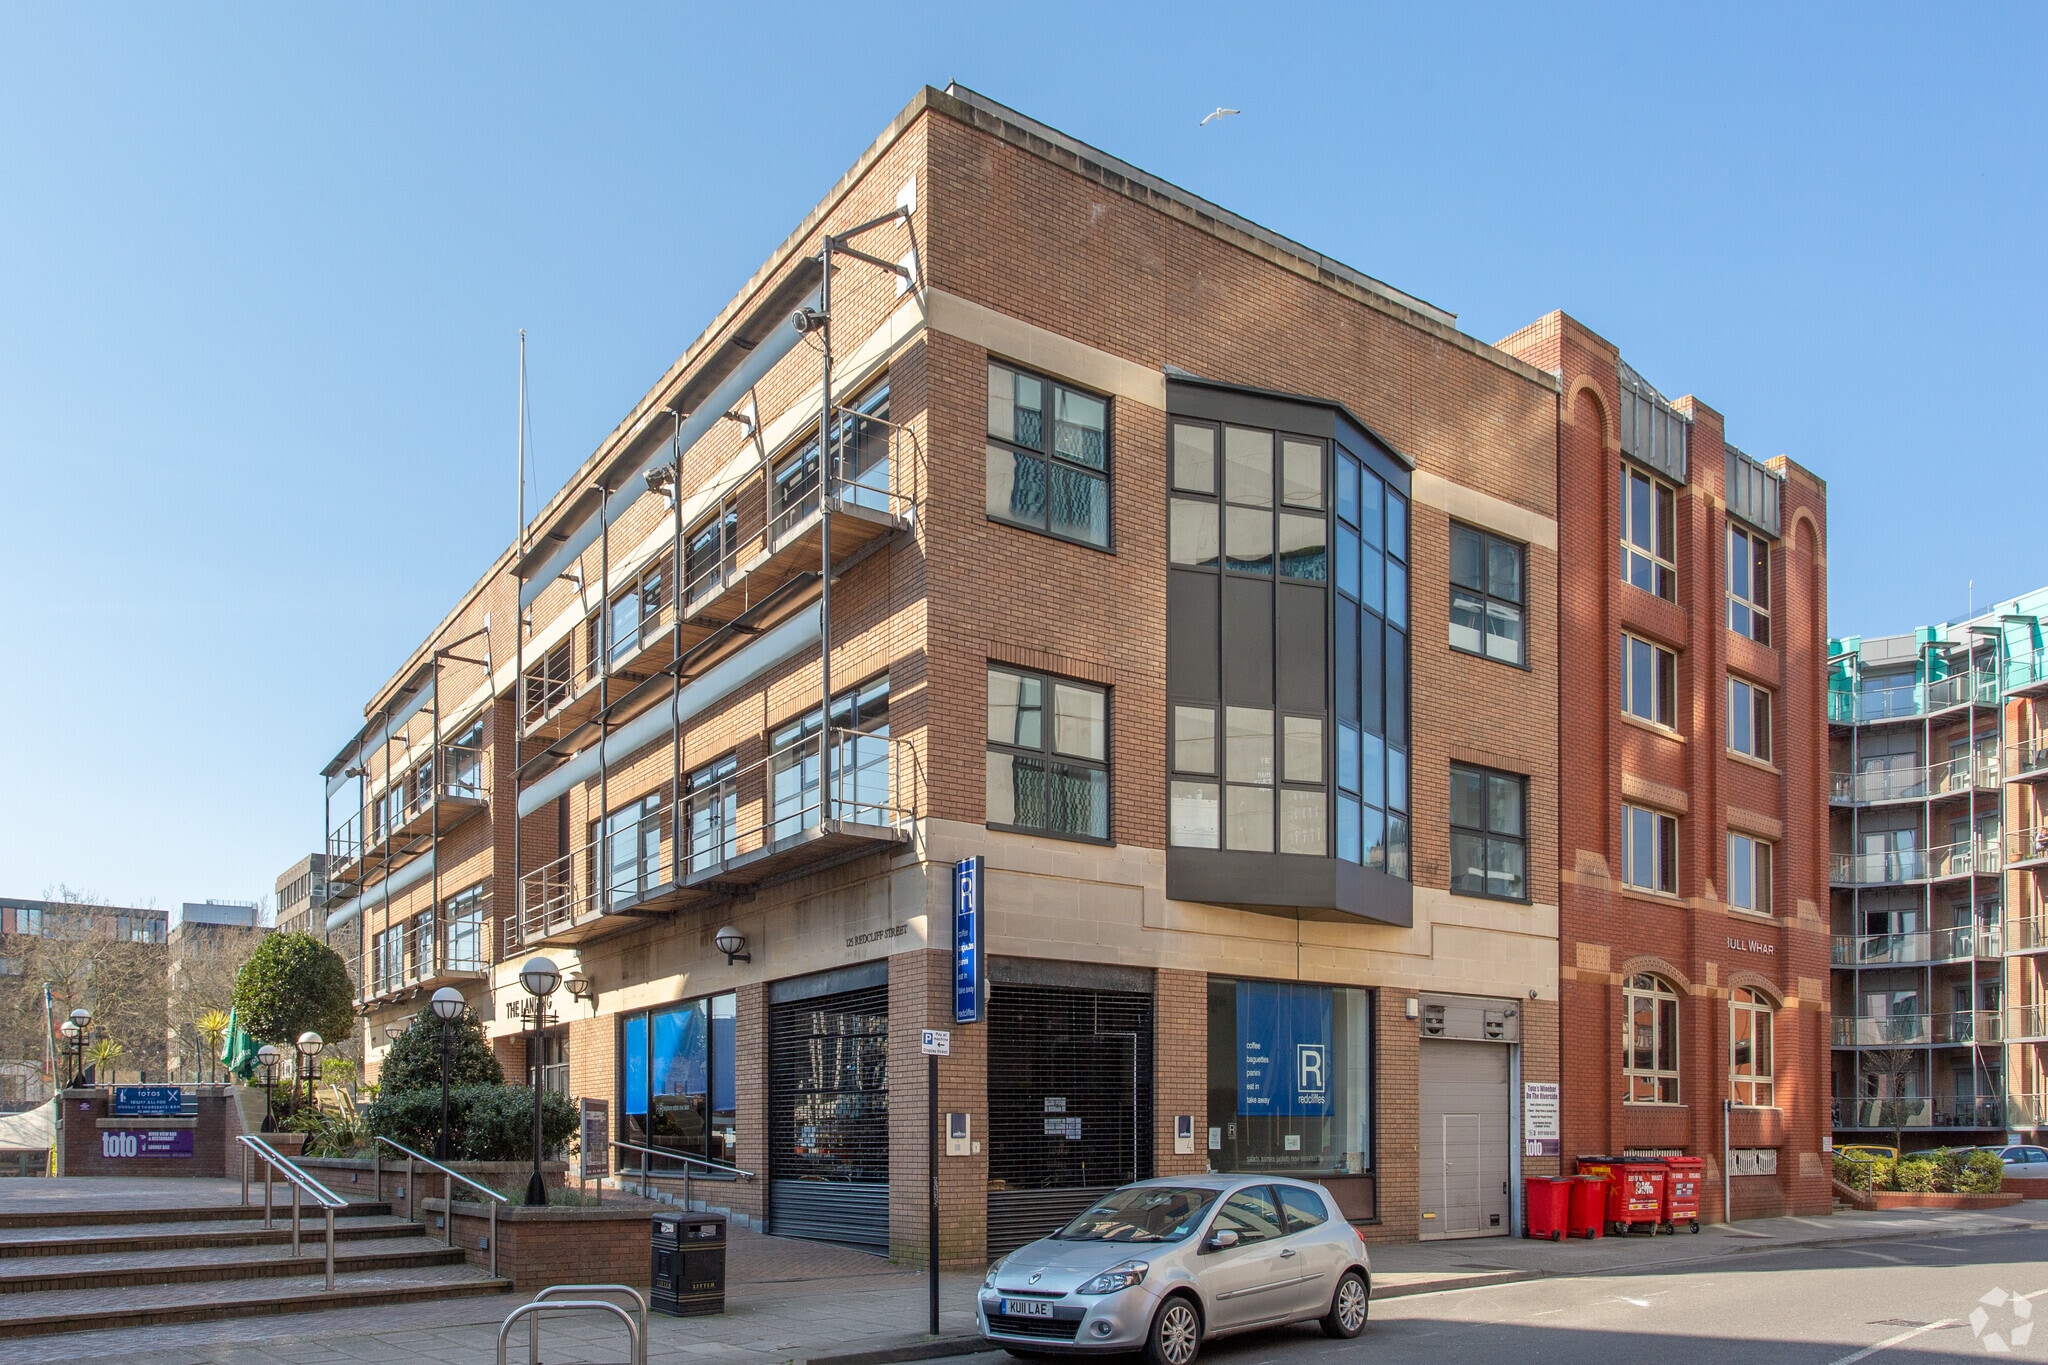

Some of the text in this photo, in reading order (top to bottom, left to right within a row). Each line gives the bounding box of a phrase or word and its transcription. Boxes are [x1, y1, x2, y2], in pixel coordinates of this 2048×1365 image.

[961, 877, 972, 910] R
[855, 930, 884, 946] REDCLIFF
[885, 924, 908, 939] STREET
[506, 1000, 520, 1019] THE
[925, 1033, 932, 1044] P
[1246, 1041, 1261, 1050] coffee
[1246, 1055, 1269, 1065] baguettes
[1246, 1069, 1261, 1078] panini
[1301, 1050, 1322, 1087] R
[1255, 1082, 1260, 1090] in
[1540, 1085, 1557, 1093] Winebar
[1246, 1096, 1271, 1106] take away
[1298, 1094, 1326, 1104] redcliffes
[1540, 1092, 1558, 1100] Riverside
[102, 1131, 137, 1158] toto
[1525, 1139, 1543, 1157] toto
[692, 1282, 715, 1290] LITTER
[1028, 1303, 1047, 1315] LAE
